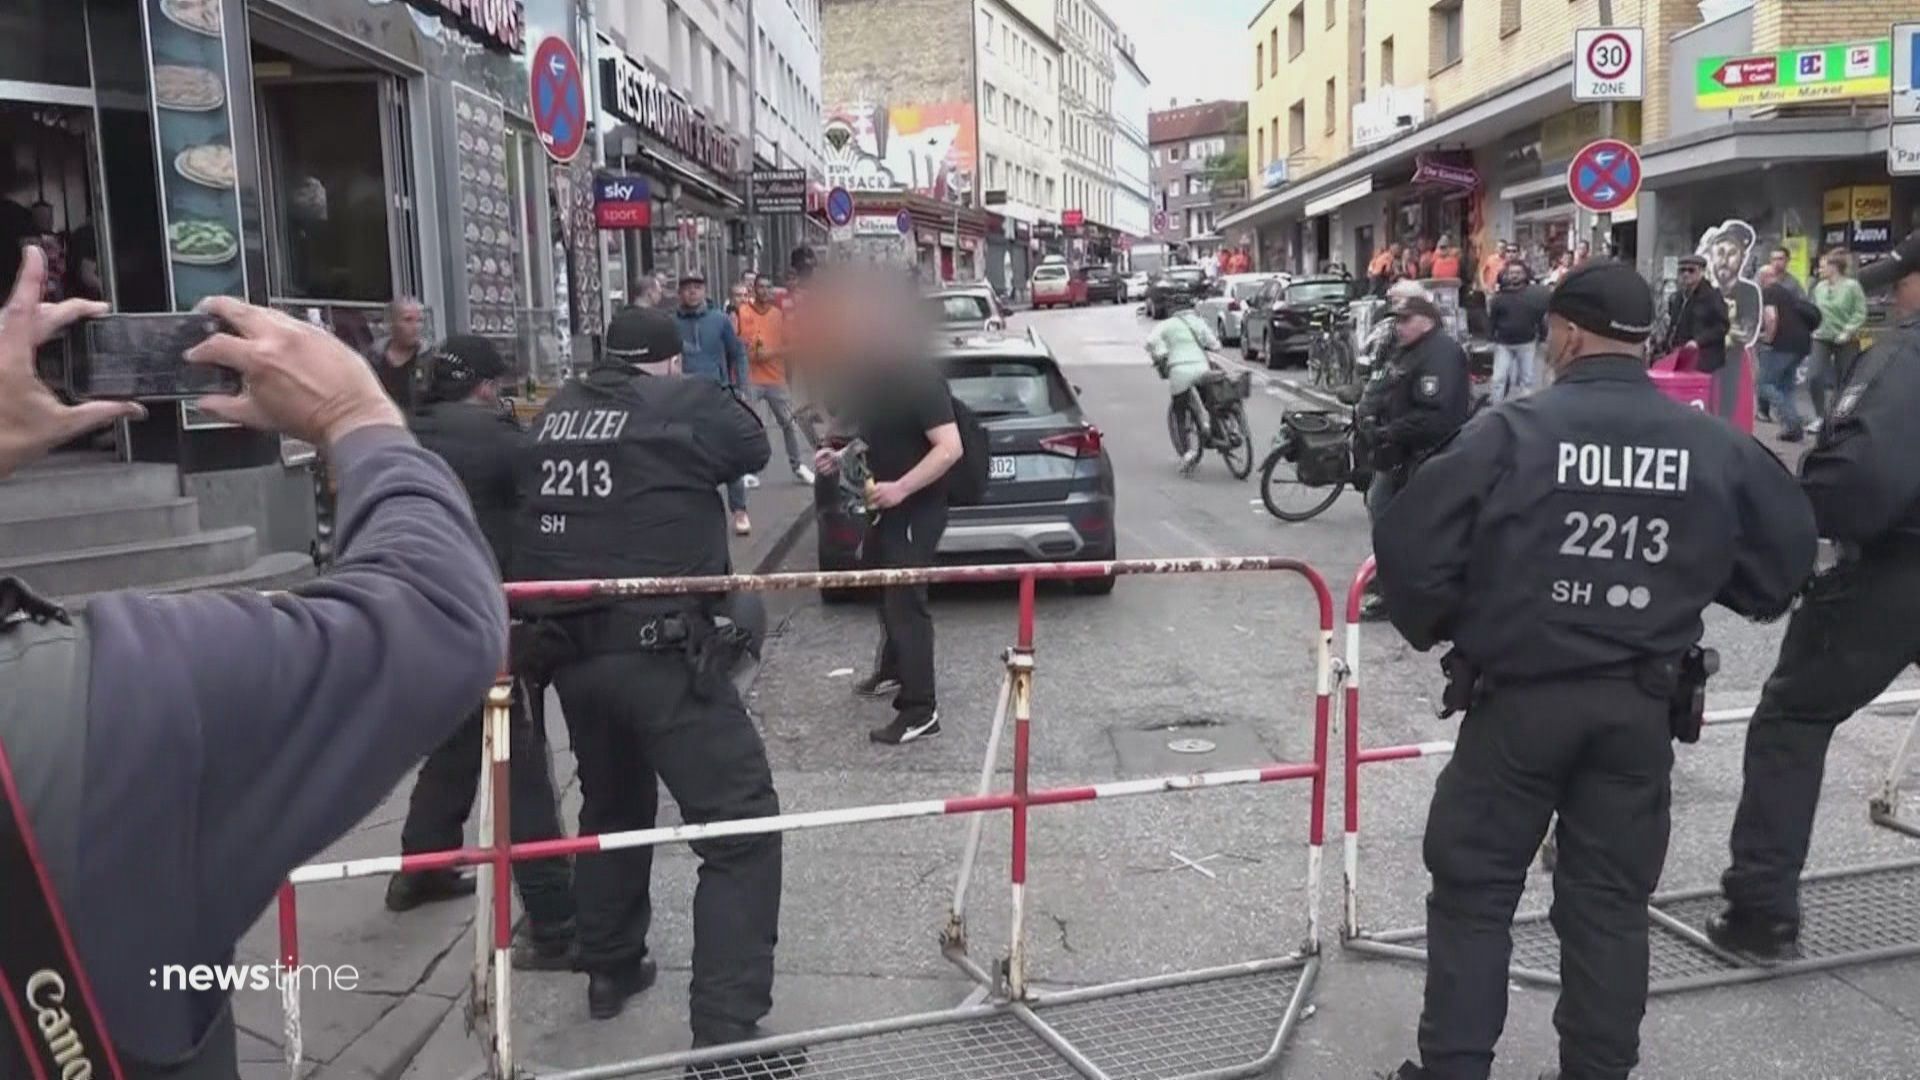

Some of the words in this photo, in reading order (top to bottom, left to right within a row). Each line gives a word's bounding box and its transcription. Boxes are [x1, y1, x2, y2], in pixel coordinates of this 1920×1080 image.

[1597, 46, 1622, 67] 30
[1592, 82, 1626, 95] ZONE
[1759, 88, 1785, 100] Mini
[1799, 85, 1843, 97] Market
[604, 182, 634, 201] sky
[538, 410, 629, 442] POLIZEI
[540, 459, 614, 497] 2213
[1557, 442, 1690, 491] POLIZEI
[540, 514, 566, 533] SH
[1559, 511, 1670, 563] 2213
[1551, 580, 1593, 605] SH
